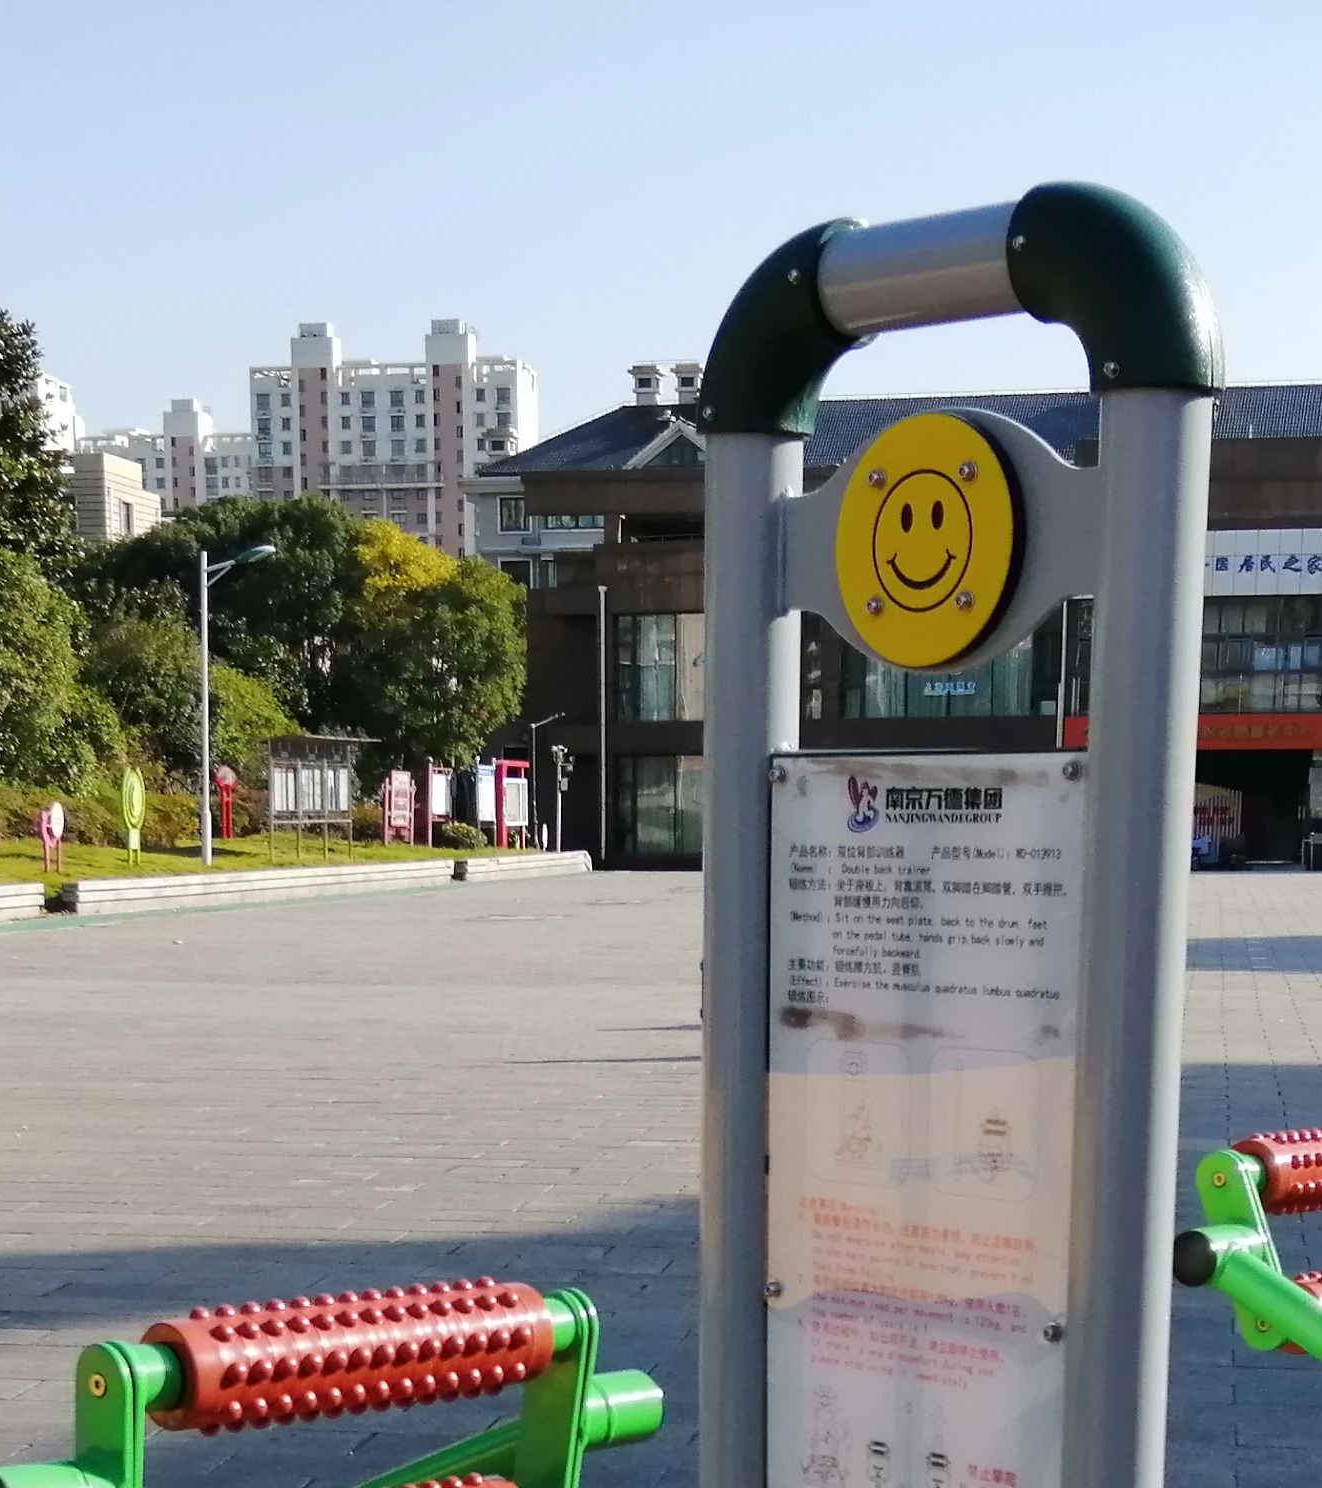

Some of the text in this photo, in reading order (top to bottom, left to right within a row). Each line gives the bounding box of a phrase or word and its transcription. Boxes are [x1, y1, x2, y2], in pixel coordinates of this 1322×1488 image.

[885, 786, 1003, 811] 南京万德集团
